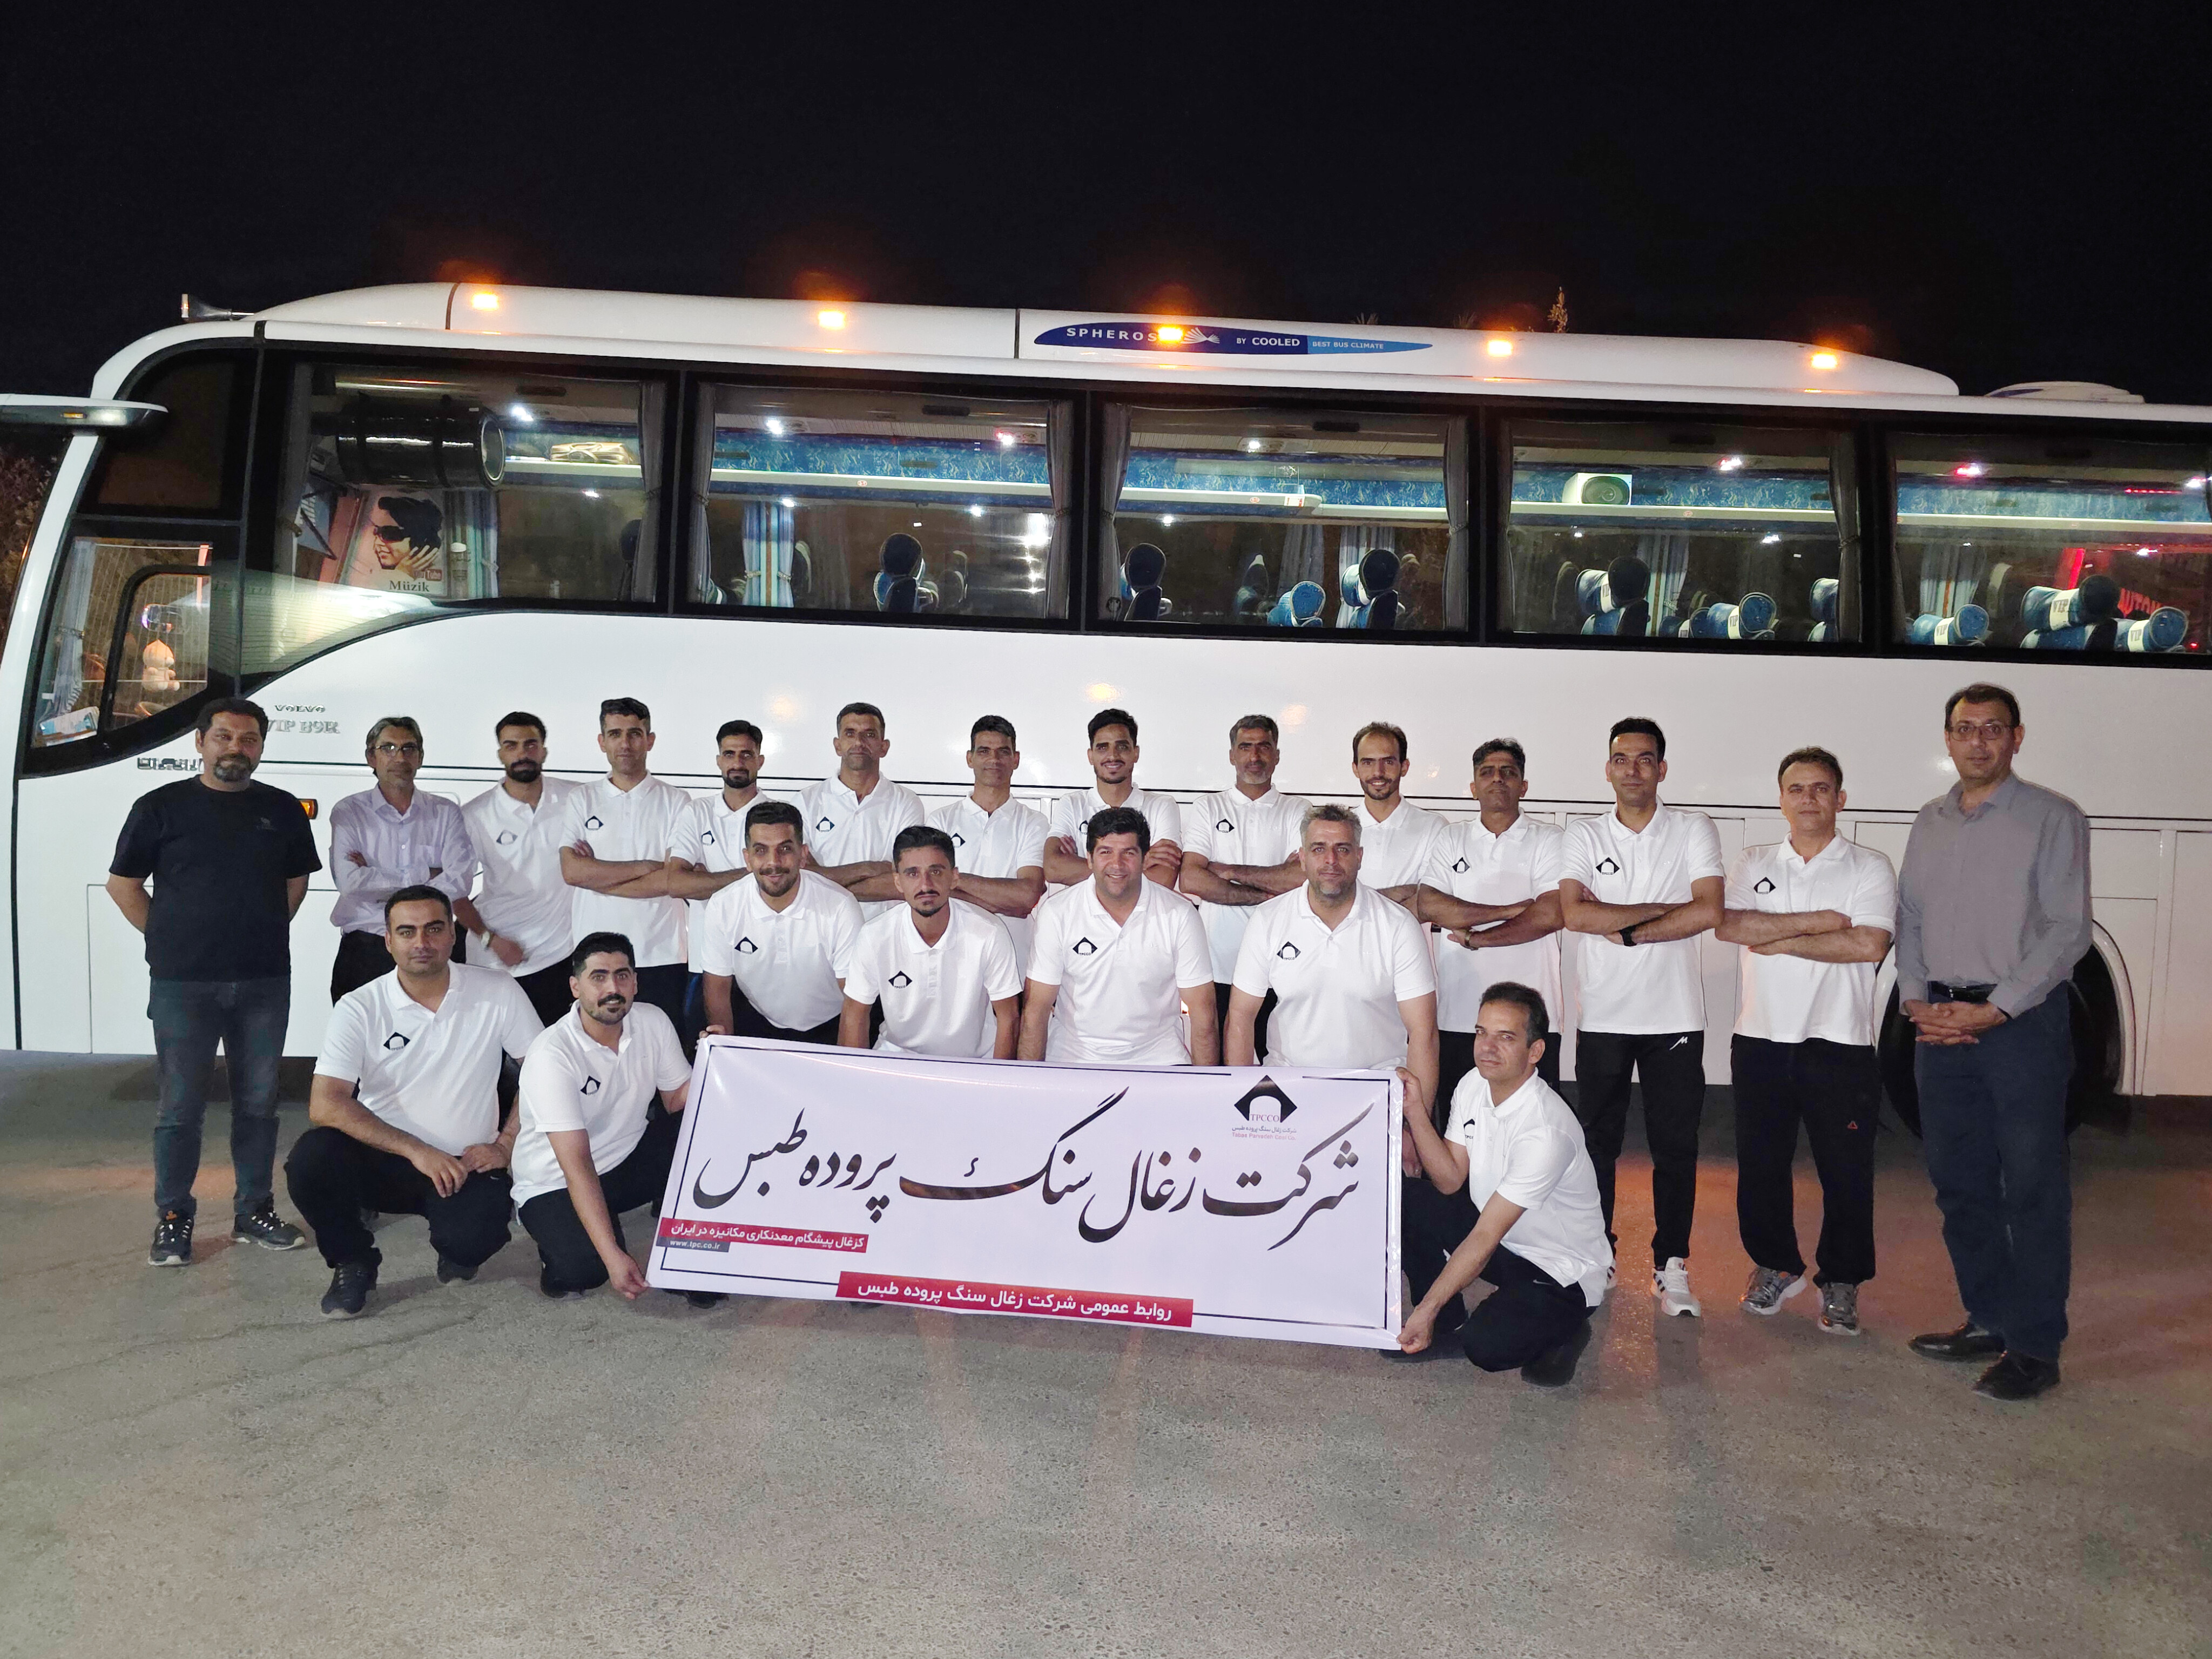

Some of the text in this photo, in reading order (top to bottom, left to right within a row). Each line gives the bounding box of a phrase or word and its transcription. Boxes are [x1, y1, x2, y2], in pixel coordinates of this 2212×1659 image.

[1066, 327, 1157, 342] SPHEROS
[1252, 337, 1300, 346] COOLED
[389, 579, 430, 592] Müzik
[274, 704, 326, 713] VOLVO
[299, 720, 341, 734] B9R
[1250, 1114, 1279, 1122] TPCCO
[692, 1107, 808, 1210] طبس
[1202, 1102, 1374, 1251] شرکت
[799, 1151, 898, 1223] پروده
[1078, 1147, 1201, 1243] زغال
[671, 1223, 696, 1236] ایران
[695, 1226, 708, 1237] در
[709, 1226, 745, 1238] مکانیزه
[746, 1229, 794, 1242] معدنکاری
[795, 1232, 834, 1249] پیشگام
[858, 1282, 1172, 1321] روابط عمومی شرکت زغال سنگ پروده طبس
